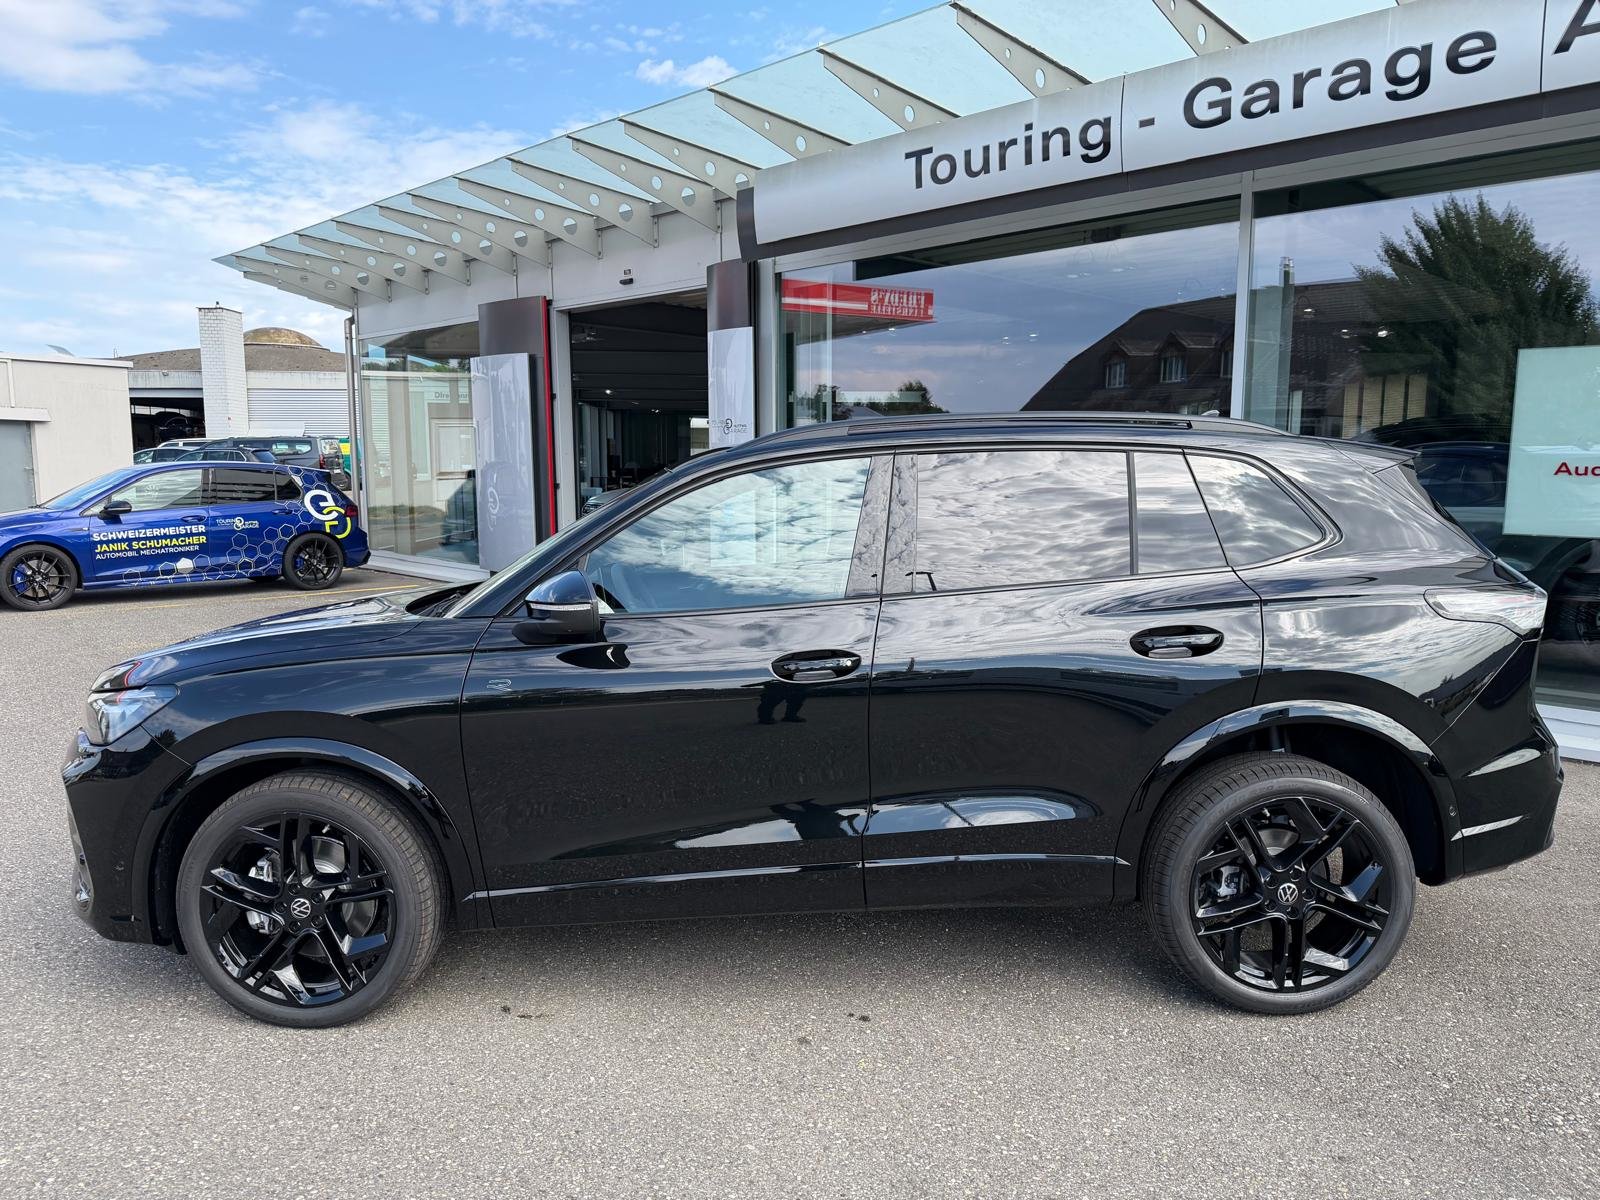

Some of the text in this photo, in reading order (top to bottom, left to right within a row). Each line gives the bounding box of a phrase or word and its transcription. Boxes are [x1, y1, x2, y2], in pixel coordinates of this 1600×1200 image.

[904, 116, 1112, 190] Touring
[1183, 30, 1497, 129] Garage
[92, 525, 206, 541] SCHWEIZERMEISTER
[95, 535, 207, 553] JANIK SCHUMACHER
[95, 545, 200, 560] AUTOMOBIL MECHATRONIKER
